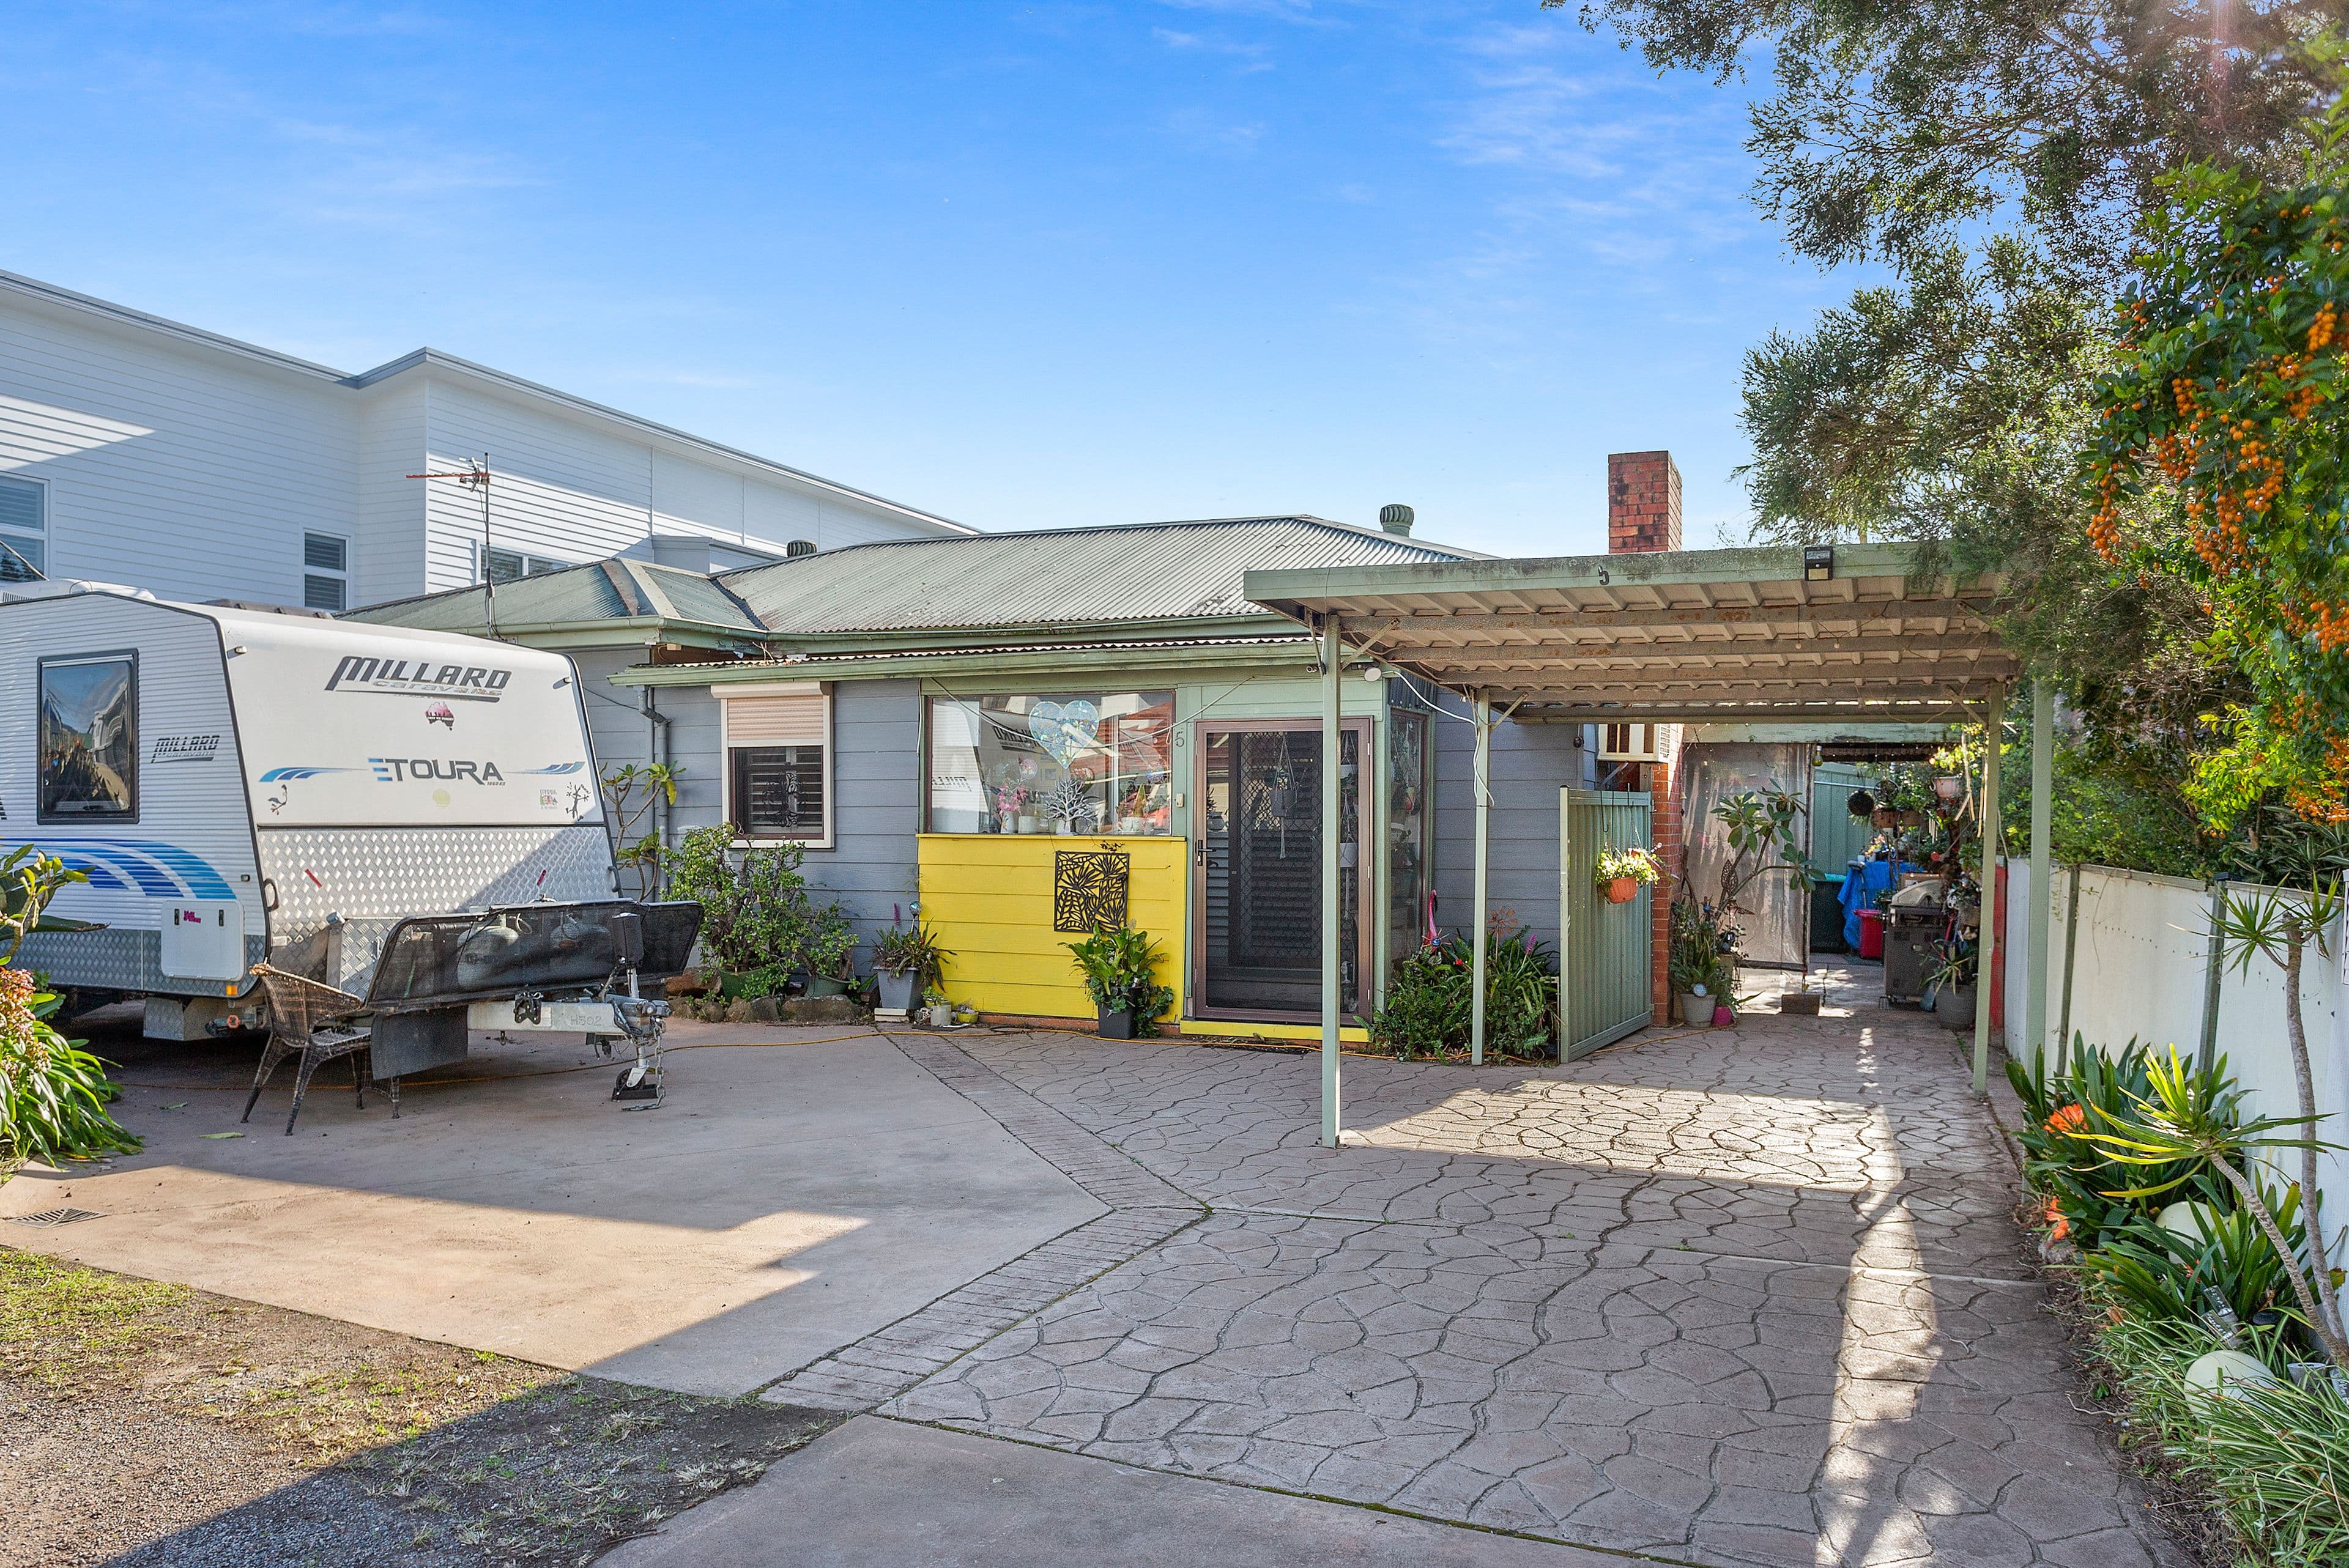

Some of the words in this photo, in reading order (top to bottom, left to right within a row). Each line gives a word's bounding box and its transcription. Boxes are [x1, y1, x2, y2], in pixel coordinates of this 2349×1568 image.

[1598, 564, 1609, 585] 5
[324, 656, 513, 690] MILLARD
[150, 735, 220, 763] MILLARD
[1174, 730, 1185, 747] 5
